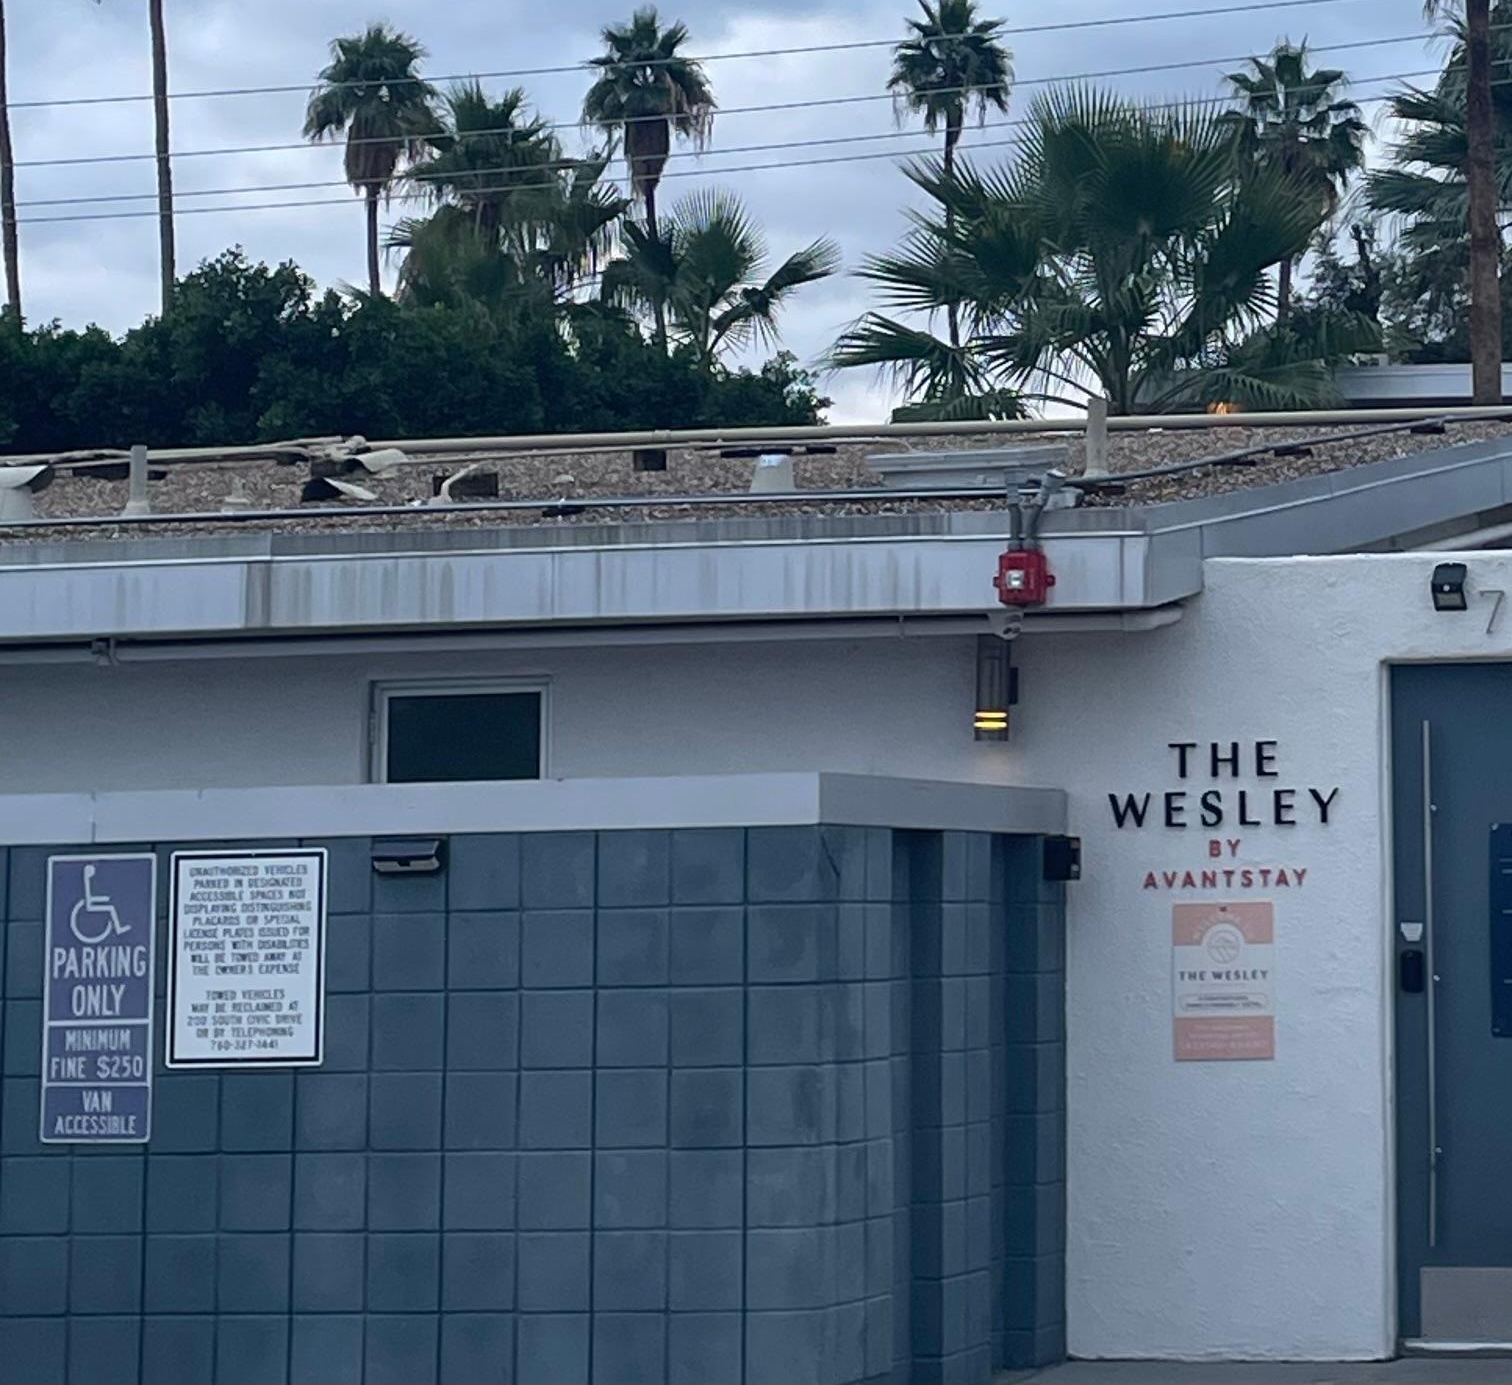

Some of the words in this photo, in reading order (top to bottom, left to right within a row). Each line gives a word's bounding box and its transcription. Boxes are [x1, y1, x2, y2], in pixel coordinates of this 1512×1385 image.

[1168, 740, 1279, 779] THE
[1108, 787, 1340, 829] WESLEY
[1208, 839, 1241, 858] BY
[1143, 868, 1309, 890] AVANTSTAY
[52, 945, 147, 979] PARKING
[1179, 970, 1206, 981] THE
[1211, 969, 1268, 981] WESLEY
[71, 984, 126, 1017] ONLY
[64, 1028, 131, 1051] MINIMUM
[50, 1057, 85, 1079] FINE
[97, 1056, 143, 1079] $250
[82, 1090, 113, 1113] VAN
[54, 1115, 137, 1136] ACCESSIBLE
